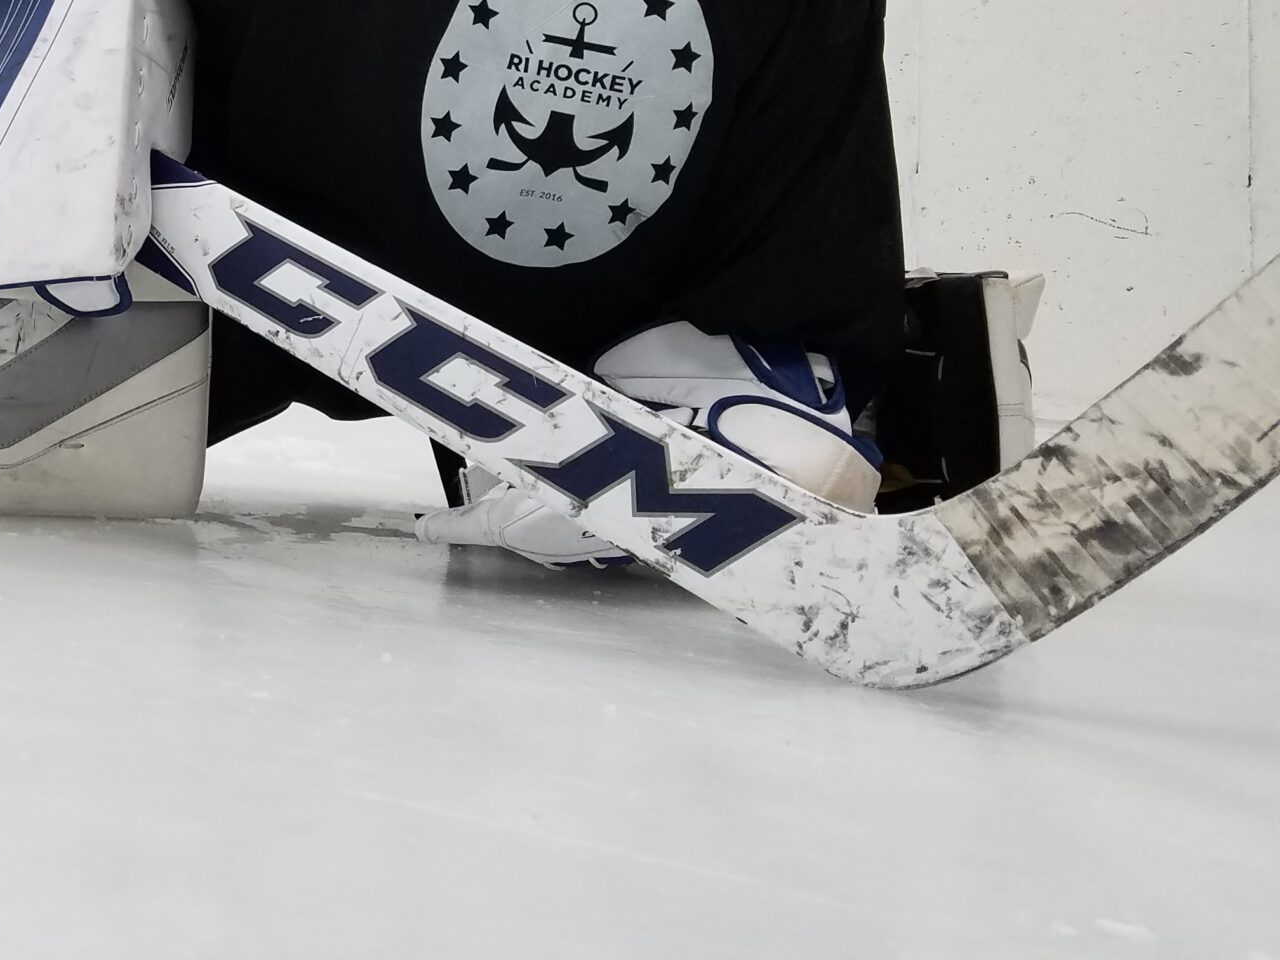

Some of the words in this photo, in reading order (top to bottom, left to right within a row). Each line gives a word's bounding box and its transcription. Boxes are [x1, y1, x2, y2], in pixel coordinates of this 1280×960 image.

[506, 52, 530, 73] RI
[536, 59, 643, 95] HOCKEY
[512, 76, 629, 110] ACADEMY
[539, 191, 563, 202] 2016
[207, 209, 807, 578] CCM
